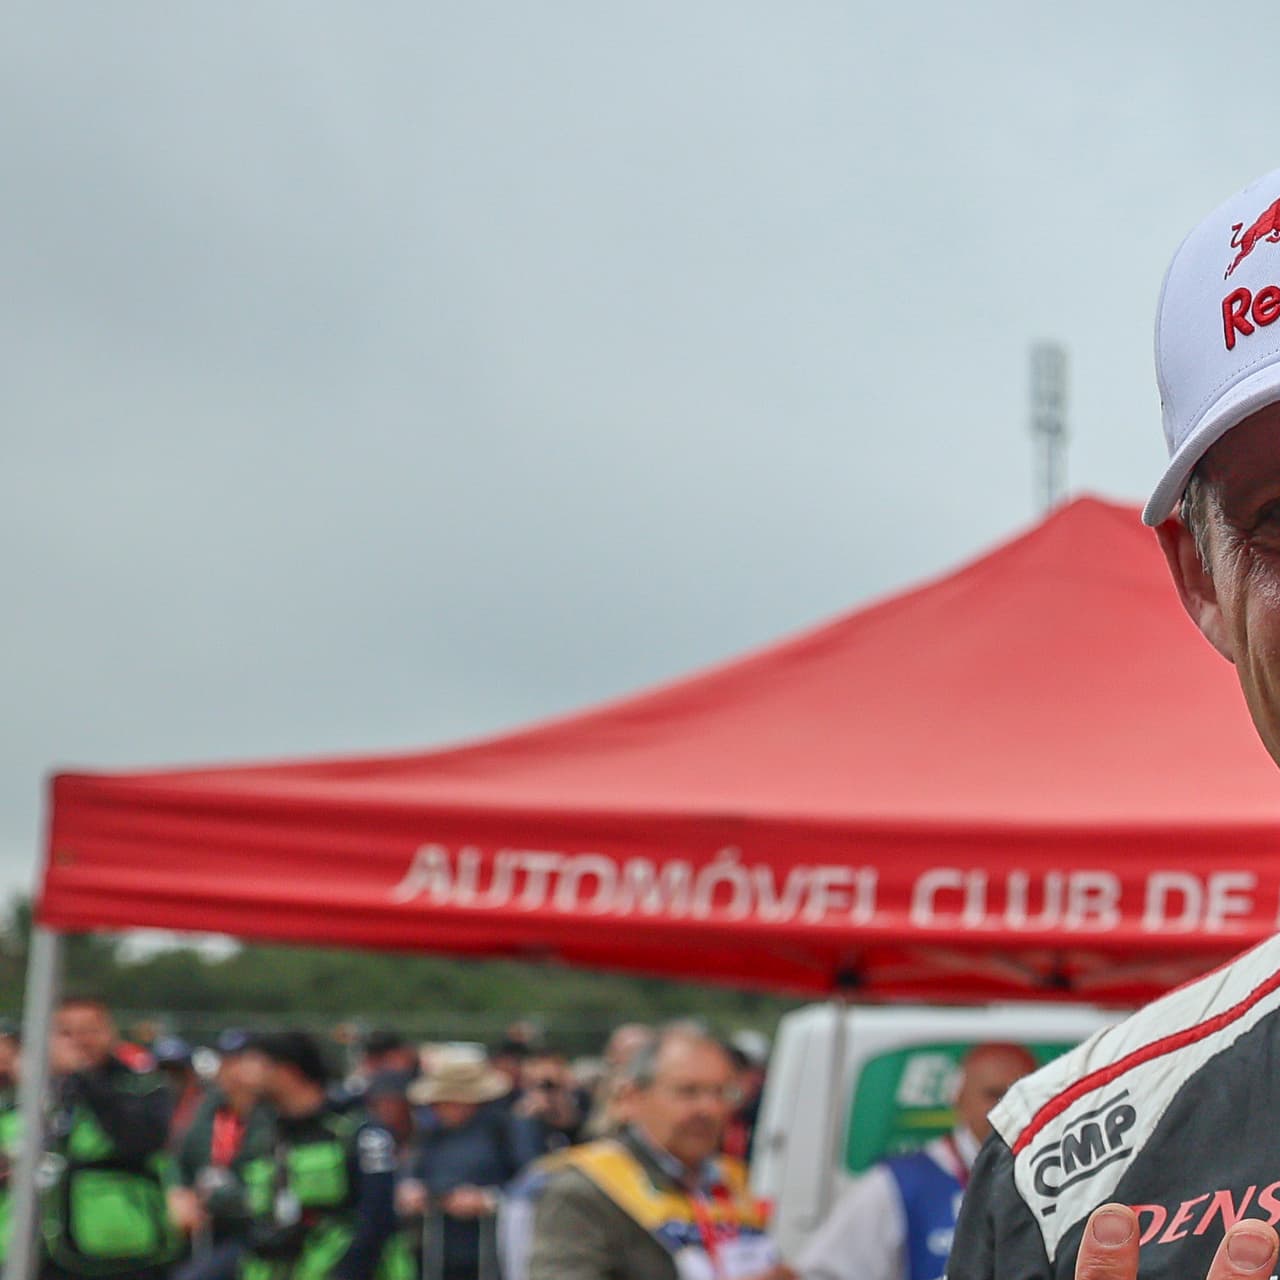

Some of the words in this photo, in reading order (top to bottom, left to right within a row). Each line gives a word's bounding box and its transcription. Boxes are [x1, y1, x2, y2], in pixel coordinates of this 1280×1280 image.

[393, 844, 880, 926] AUTOMÓVEL
[909, 867, 1125, 934] CLUB
[1142, 870, 1258, 936] DE
